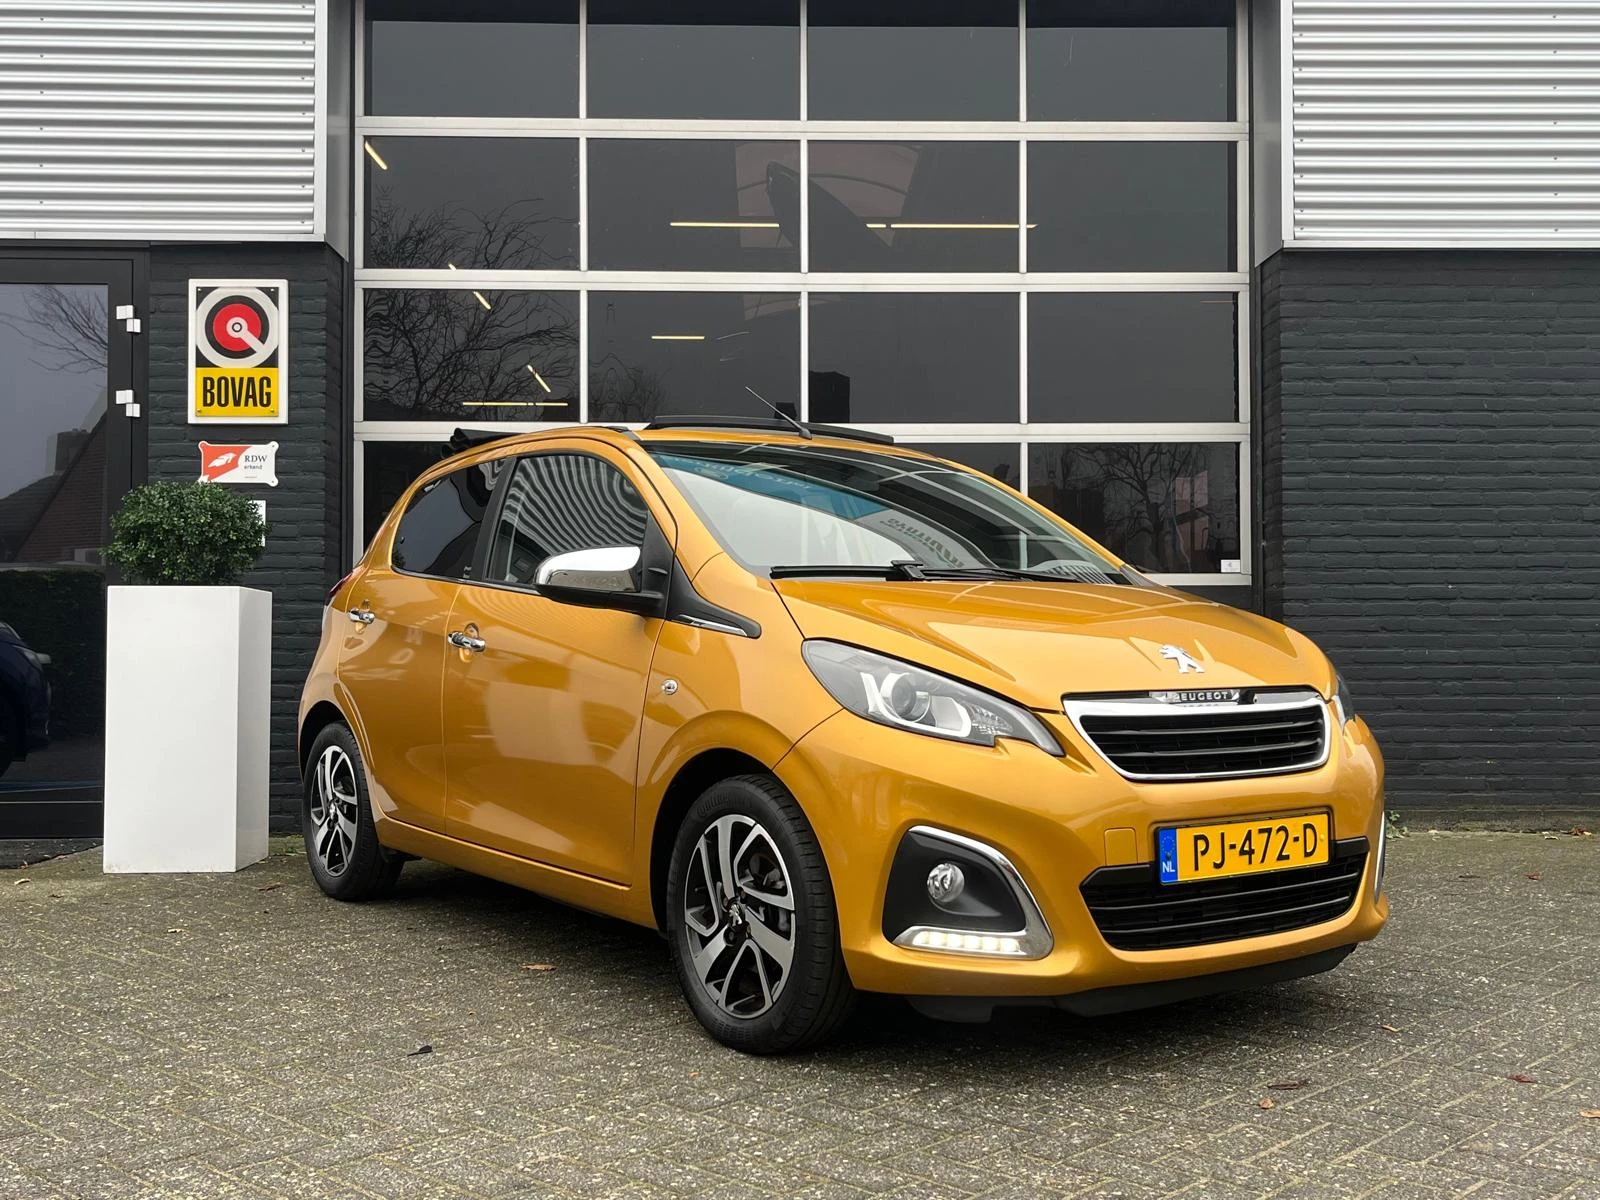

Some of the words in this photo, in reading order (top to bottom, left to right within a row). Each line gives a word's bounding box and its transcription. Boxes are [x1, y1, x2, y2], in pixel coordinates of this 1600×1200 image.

[202, 376, 272, 408] BOVAG
[244, 454, 268, 463] RDW
[1172, 691, 1228, 702] PEUGEOT
[1193, 822, 1318, 871] PJ-472-D
[1162, 861, 1176, 873] NL
